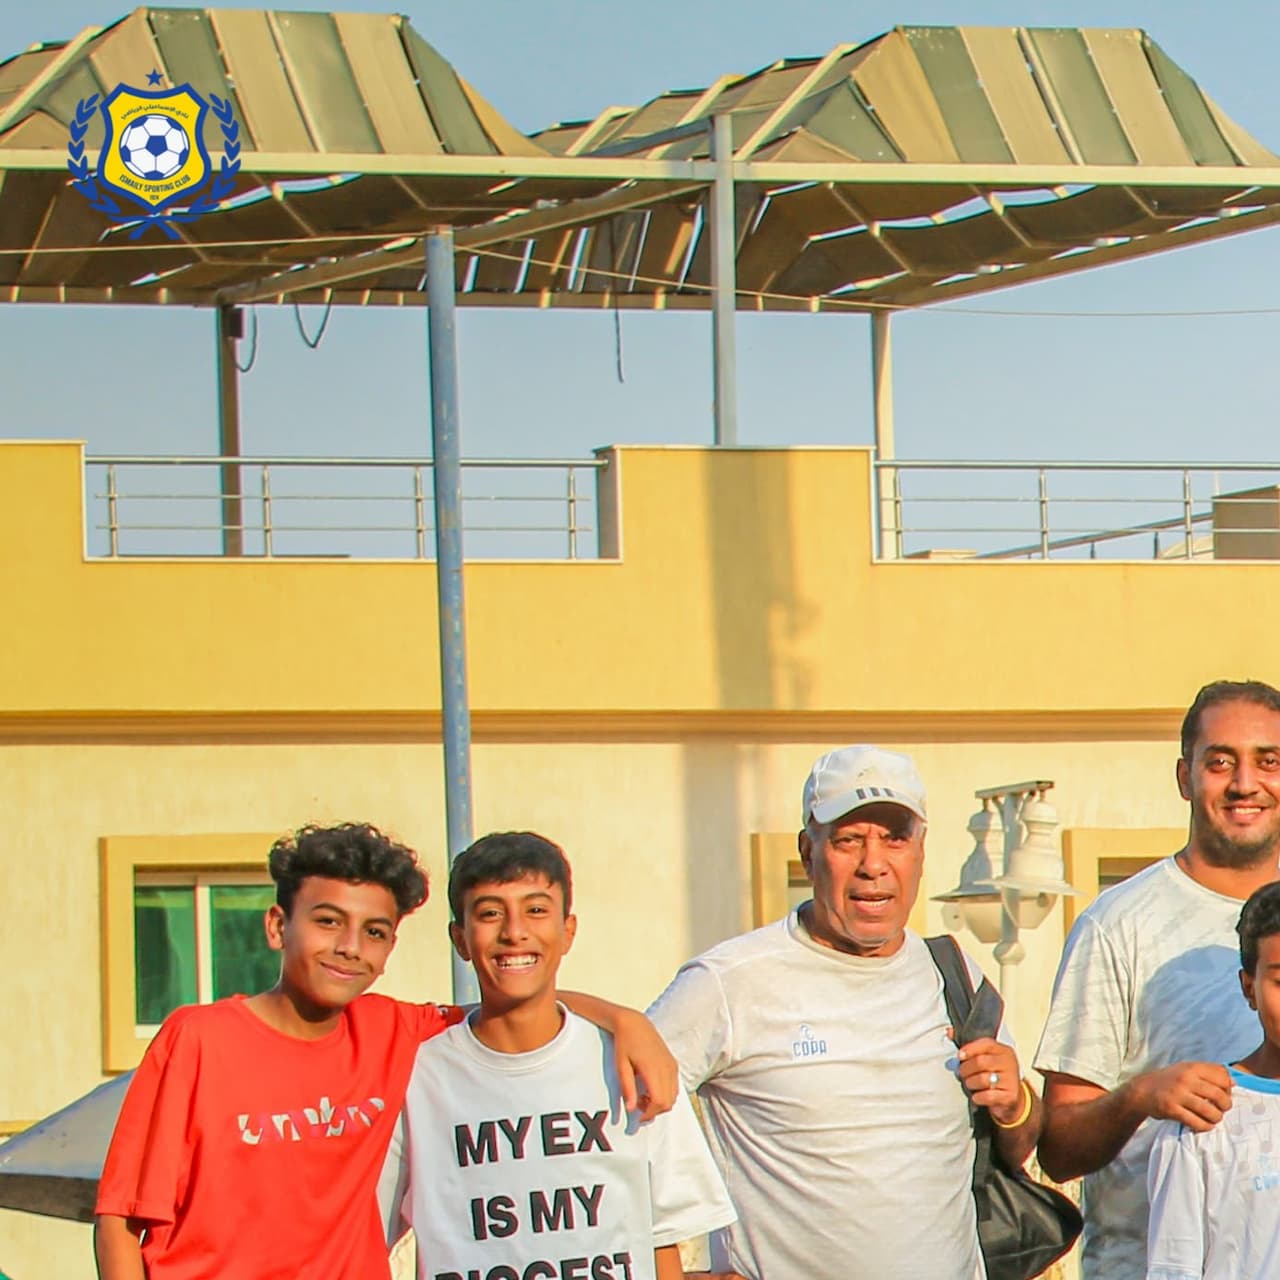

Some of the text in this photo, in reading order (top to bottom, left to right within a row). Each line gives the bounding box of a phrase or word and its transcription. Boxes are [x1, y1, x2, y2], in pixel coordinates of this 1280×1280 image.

[793, 1039, 828, 1057] COPA
[455, 1110, 614, 1168] MY EX
[471, 1184, 605, 1241] IS MY
